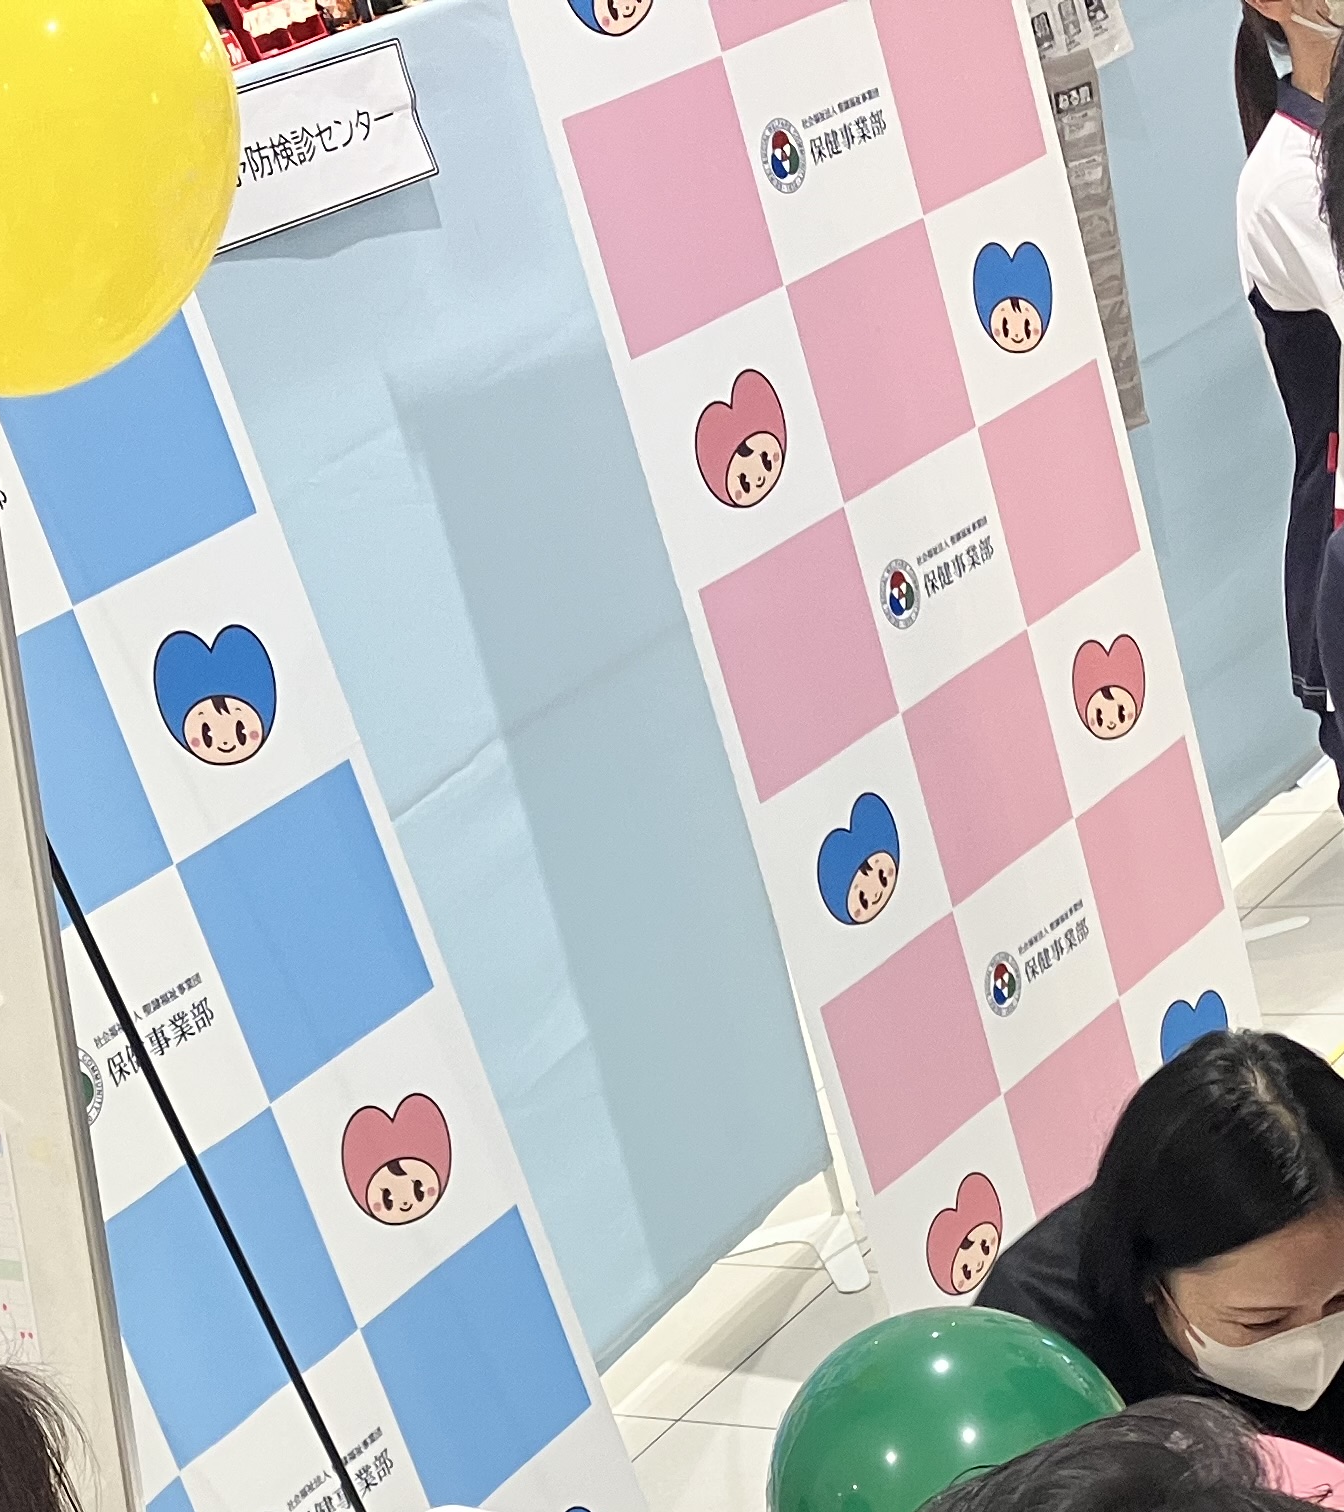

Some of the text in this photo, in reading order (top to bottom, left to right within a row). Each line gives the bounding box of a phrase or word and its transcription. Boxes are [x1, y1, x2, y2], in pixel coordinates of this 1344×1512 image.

[807, 108, 887, 165] 保健事業部
[921, 535, 996, 597] 保健事業部
[1023, 916, 1091, 983] 保健事業部
[92, 1010, 143, 1049] 社会福人
